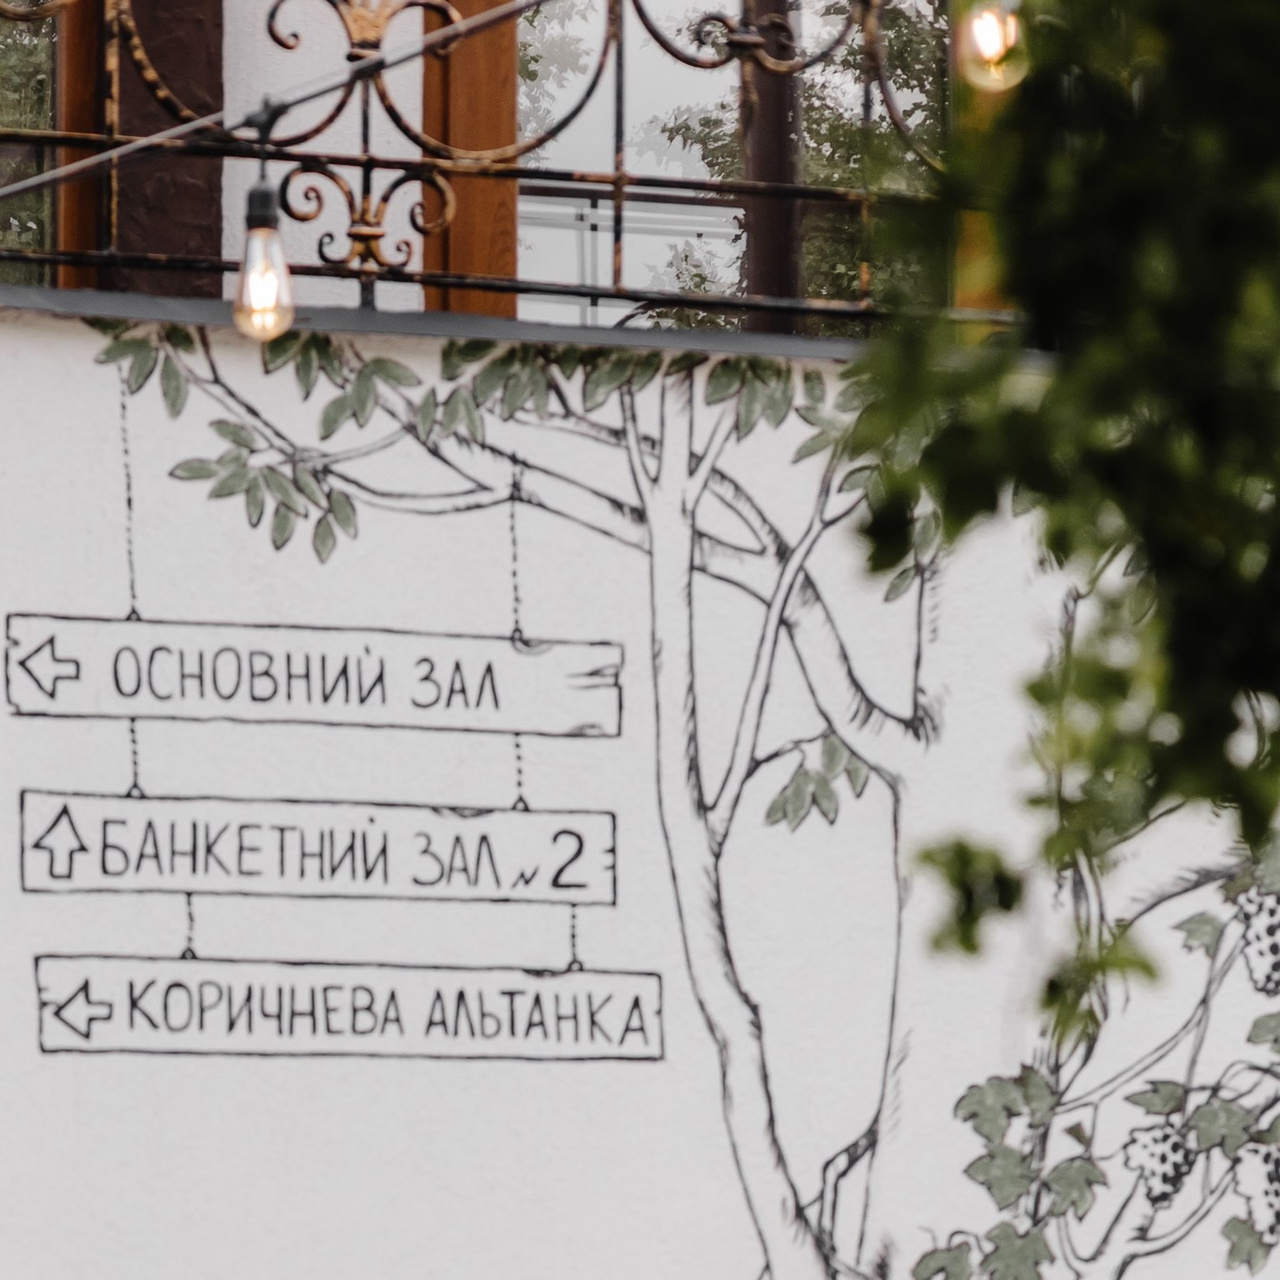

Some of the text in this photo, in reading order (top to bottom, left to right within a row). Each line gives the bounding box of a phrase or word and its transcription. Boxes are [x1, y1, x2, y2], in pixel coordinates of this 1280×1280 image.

[112, 645, 501, 710] ОСНОВНИЙ ЗАЛ
[99, 817, 391, 885] БАНКЕТНИЙ
[412, 834, 501, 888] ЗАЛ
[128, 979, 649, 1046] КОРИЧНЕВА АЛЬТАНКА
